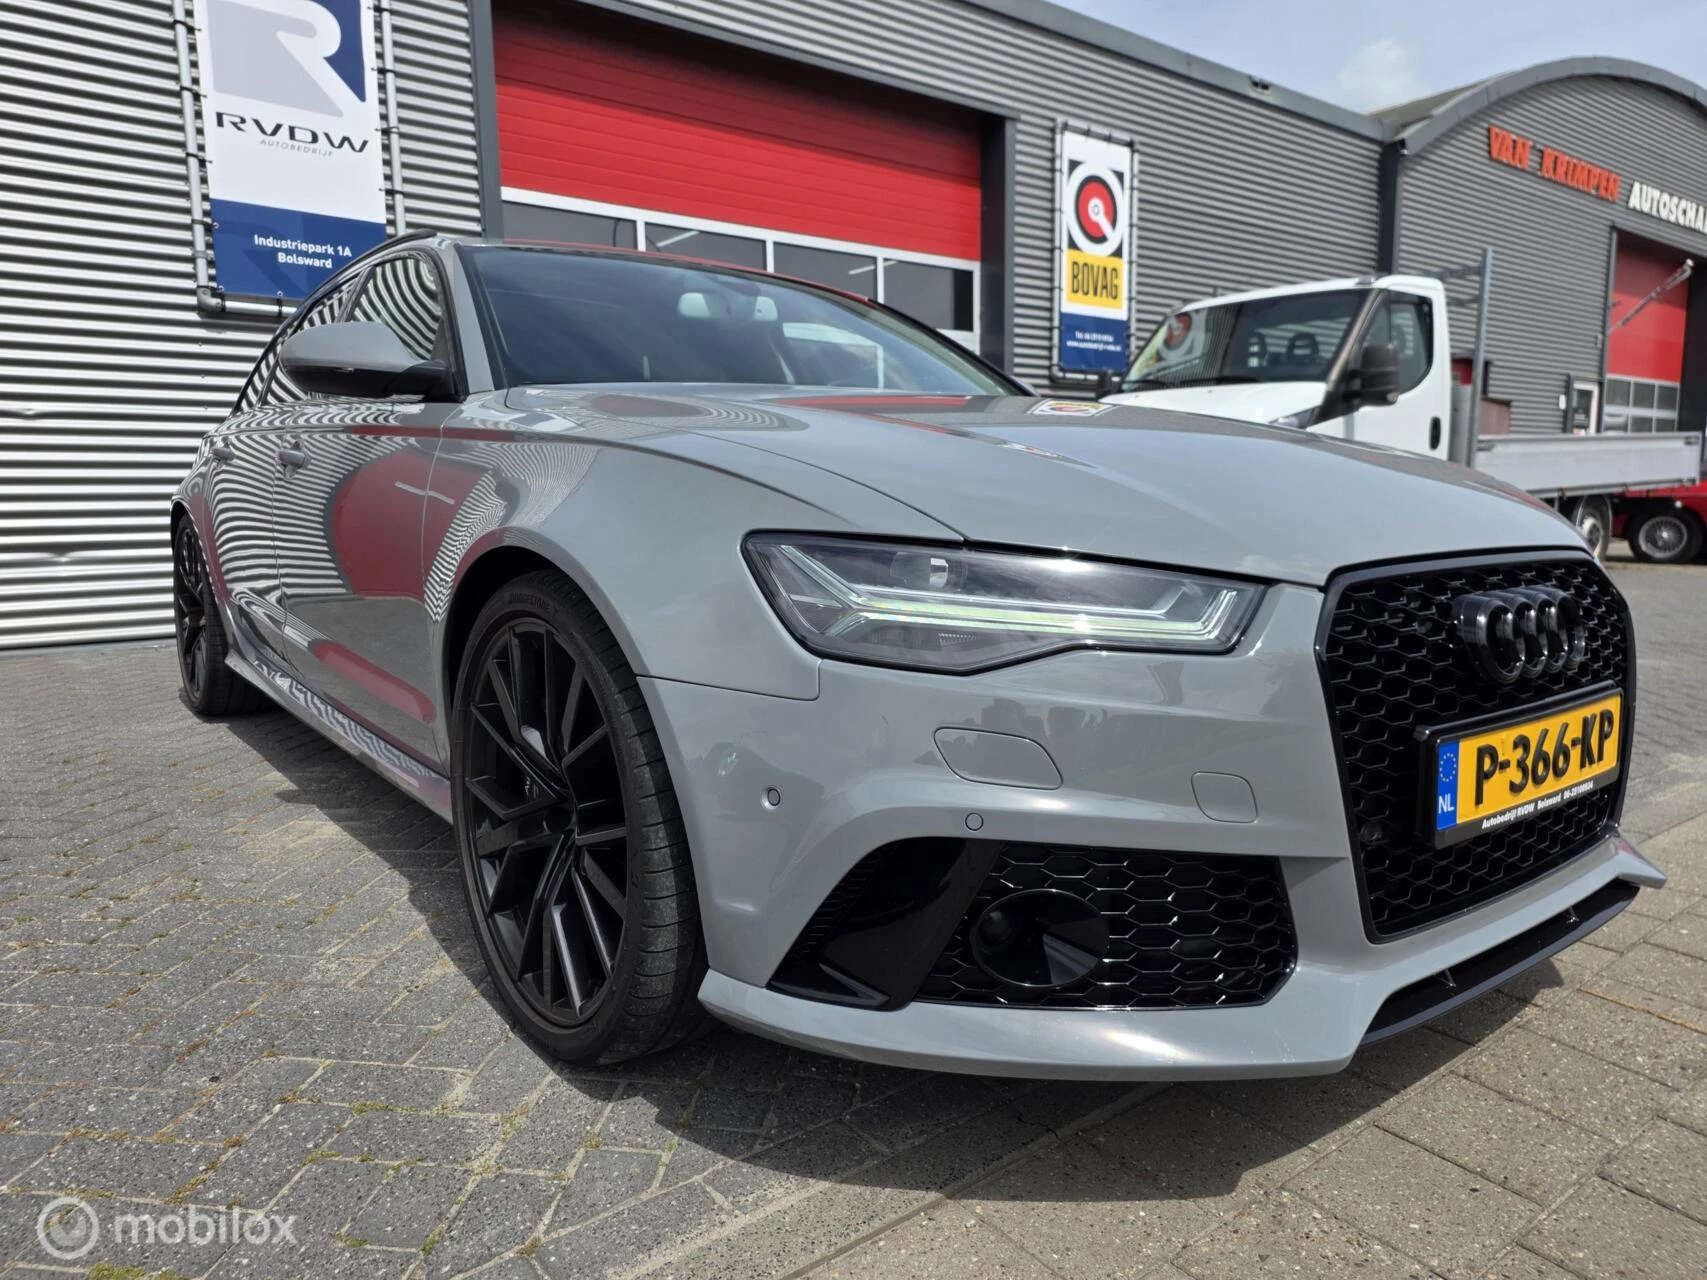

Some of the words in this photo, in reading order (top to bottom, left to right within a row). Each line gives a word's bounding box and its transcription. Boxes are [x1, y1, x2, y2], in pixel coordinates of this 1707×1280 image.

[215, 111, 369, 153] RVDW
[260, 138, 333, 157] AUTOBEDRIJF
[1488, 124, 1532, 170] VAN
[1540, 145, 1621, 203] KRIMPEN
[1628, 181, 1707, 234] AUTOSCHA
[254, 234, 335, 255] Industriepark
[337, 245, 352, 258] 1A
[277, 252, 333, 269] Bolsward
[1071, 261, 1119, 300] BOVAG
[1474, 709, 1614, 807] P-366-KP
[1438, 793, 1454, 814] NL
